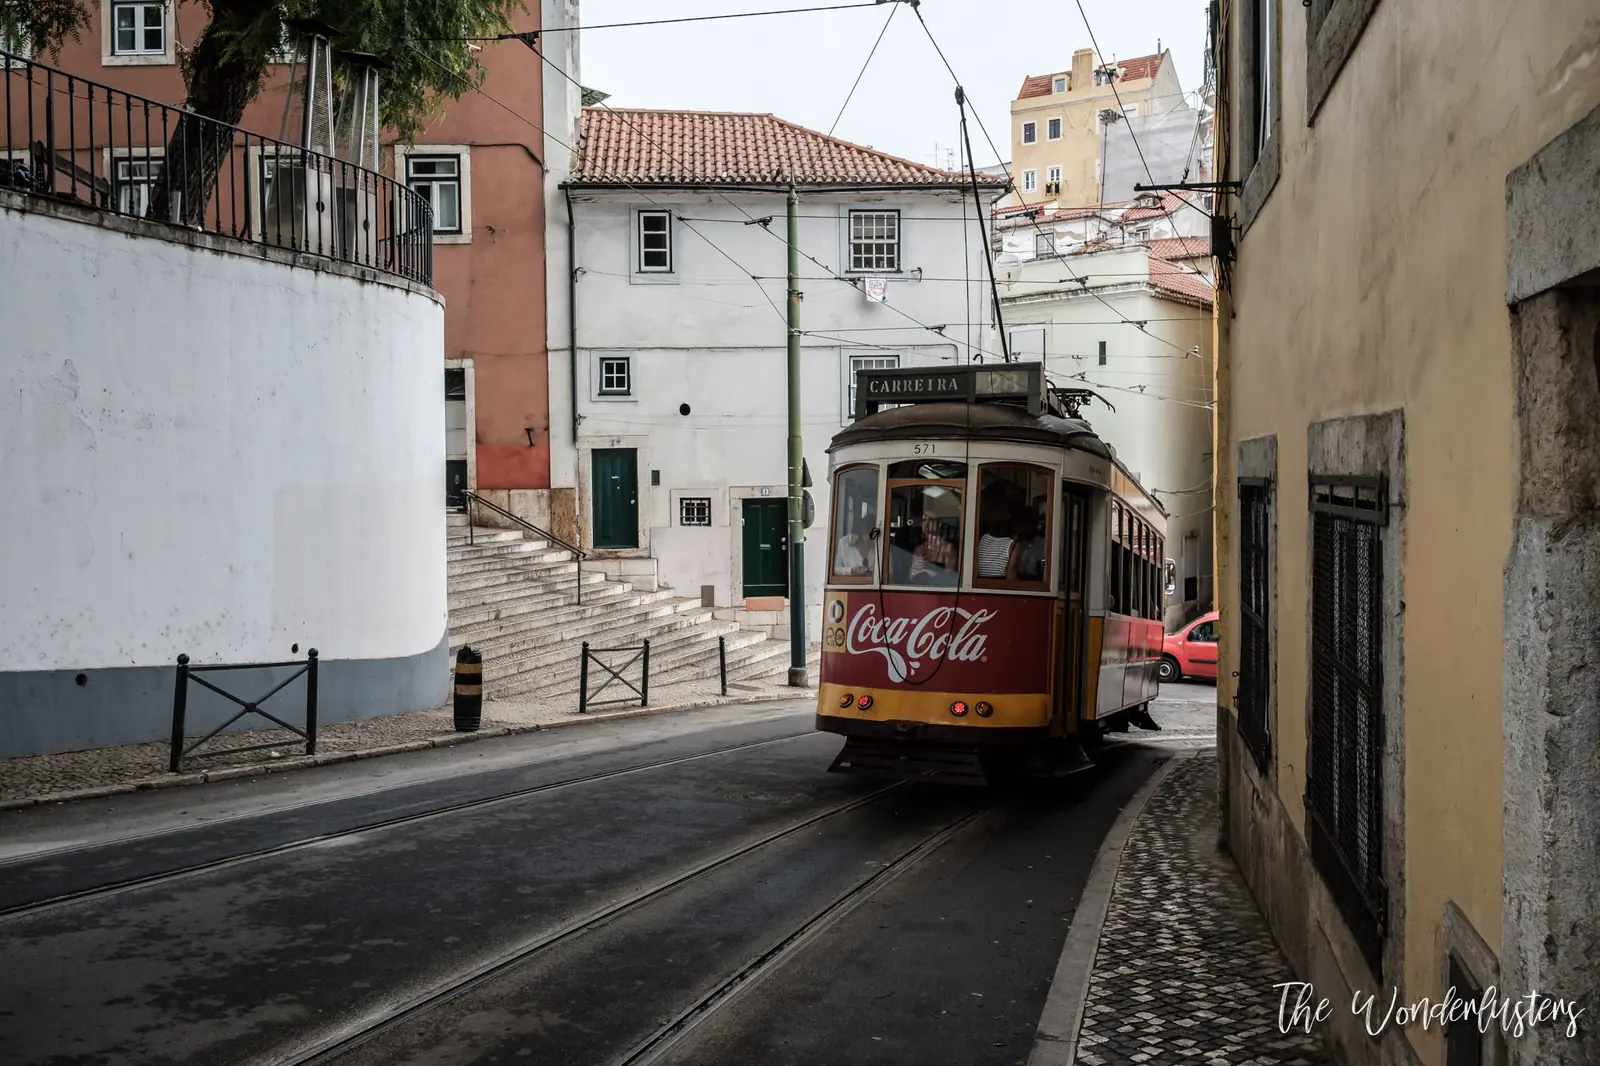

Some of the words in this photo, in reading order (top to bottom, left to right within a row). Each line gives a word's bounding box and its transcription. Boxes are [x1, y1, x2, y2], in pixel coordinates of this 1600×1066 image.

[869, 377, 959, 393] CARREIRA
[914, 444, 936, 454] 571
[846, 603, 999, 664] Coca-Cola
